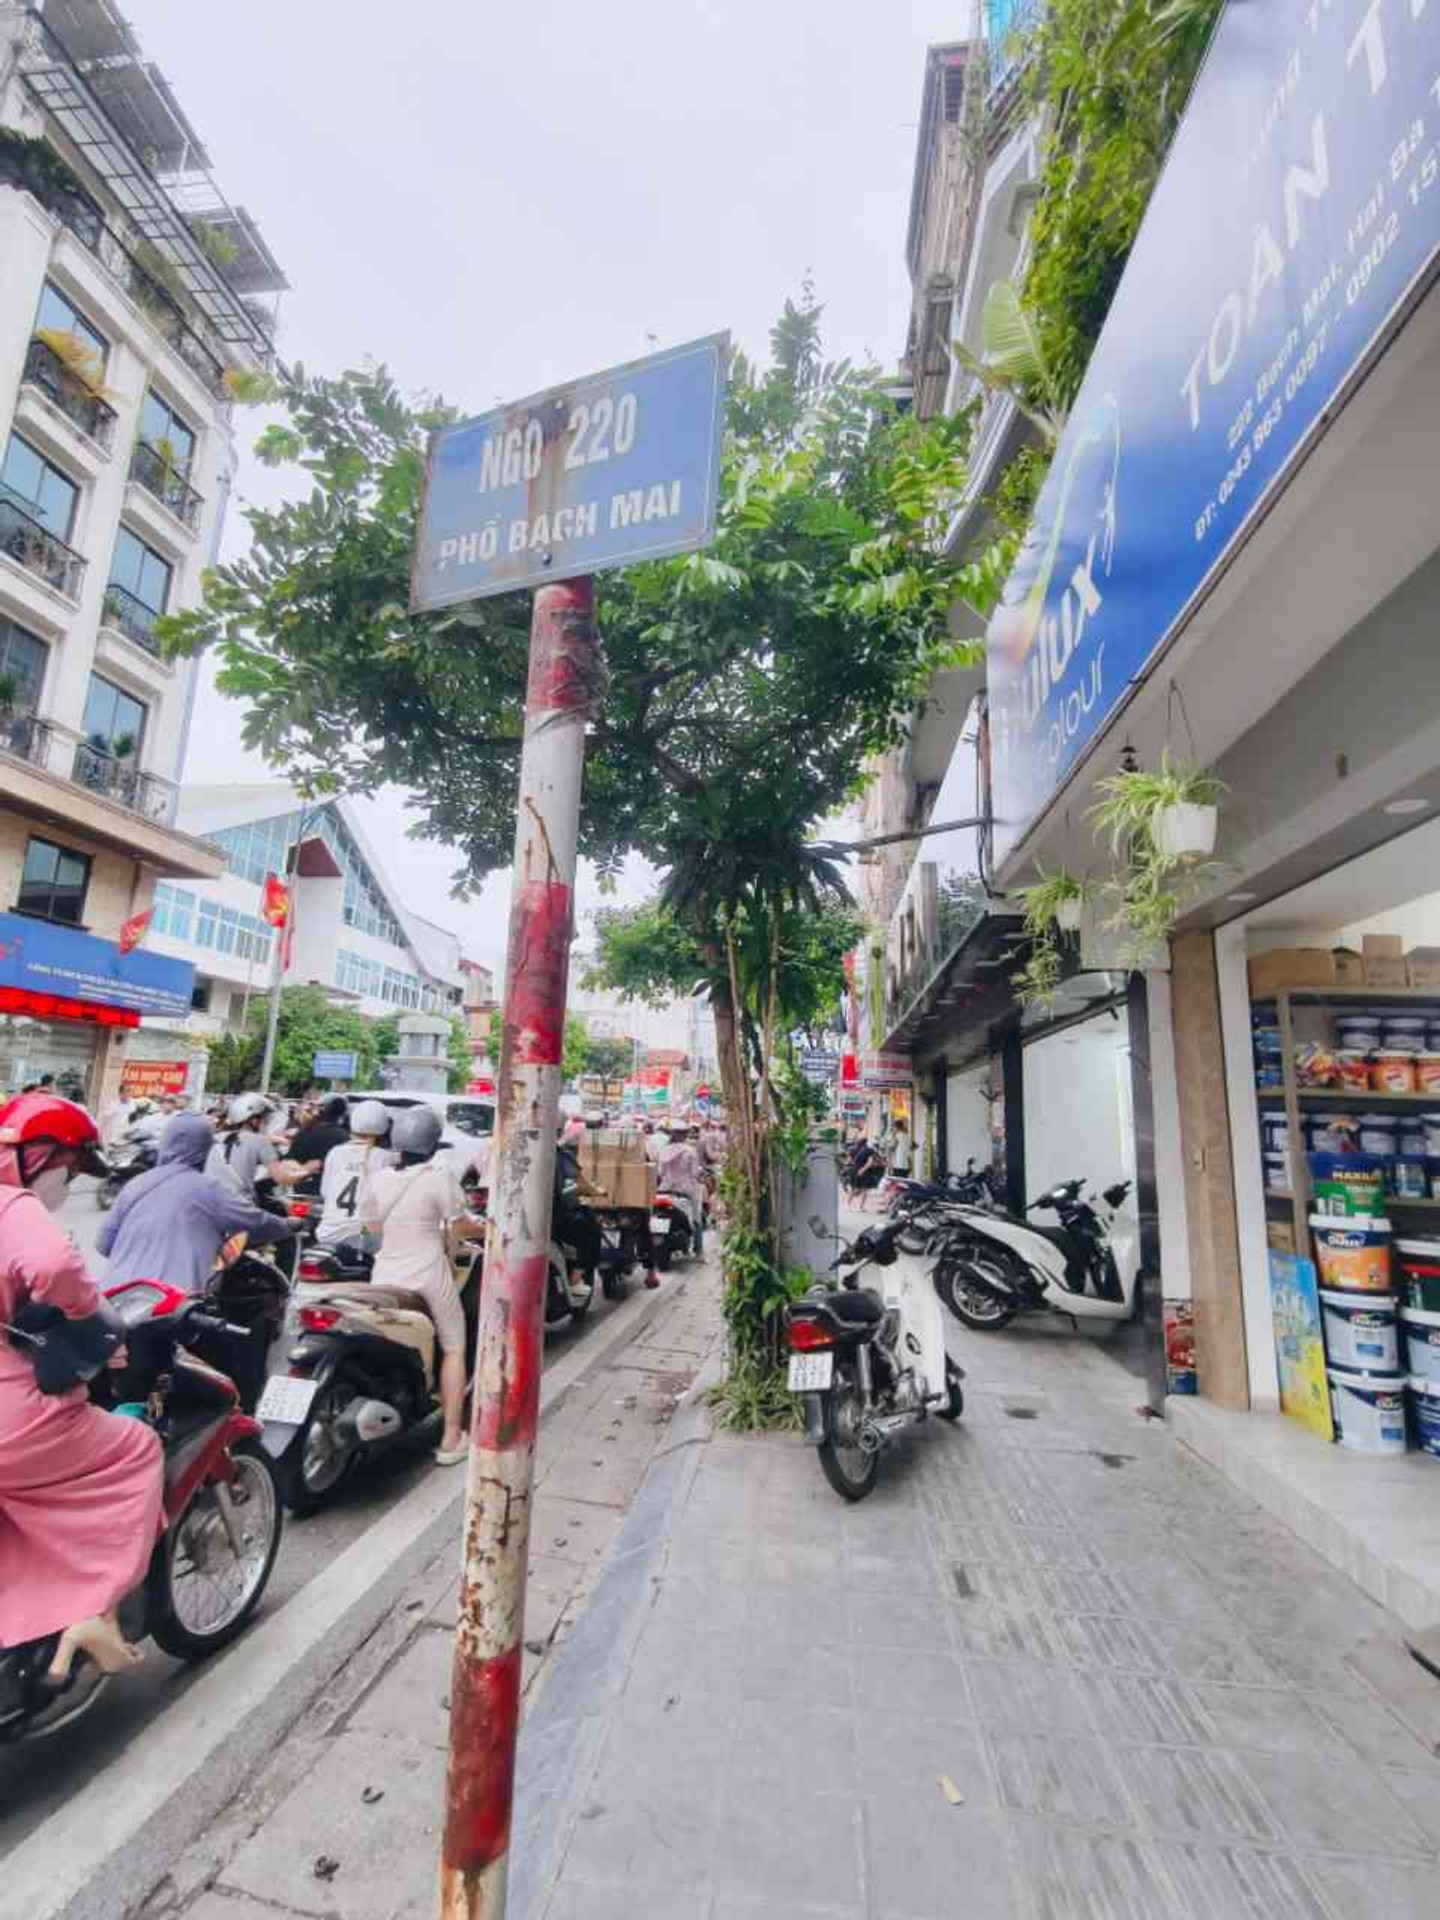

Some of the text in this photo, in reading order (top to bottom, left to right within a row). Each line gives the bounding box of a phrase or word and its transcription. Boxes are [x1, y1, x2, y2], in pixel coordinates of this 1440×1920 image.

[564, 393, 638, 471] 220
[610, 480, 682, 530] MAI
[336, 1176, 359, 1217] 4
